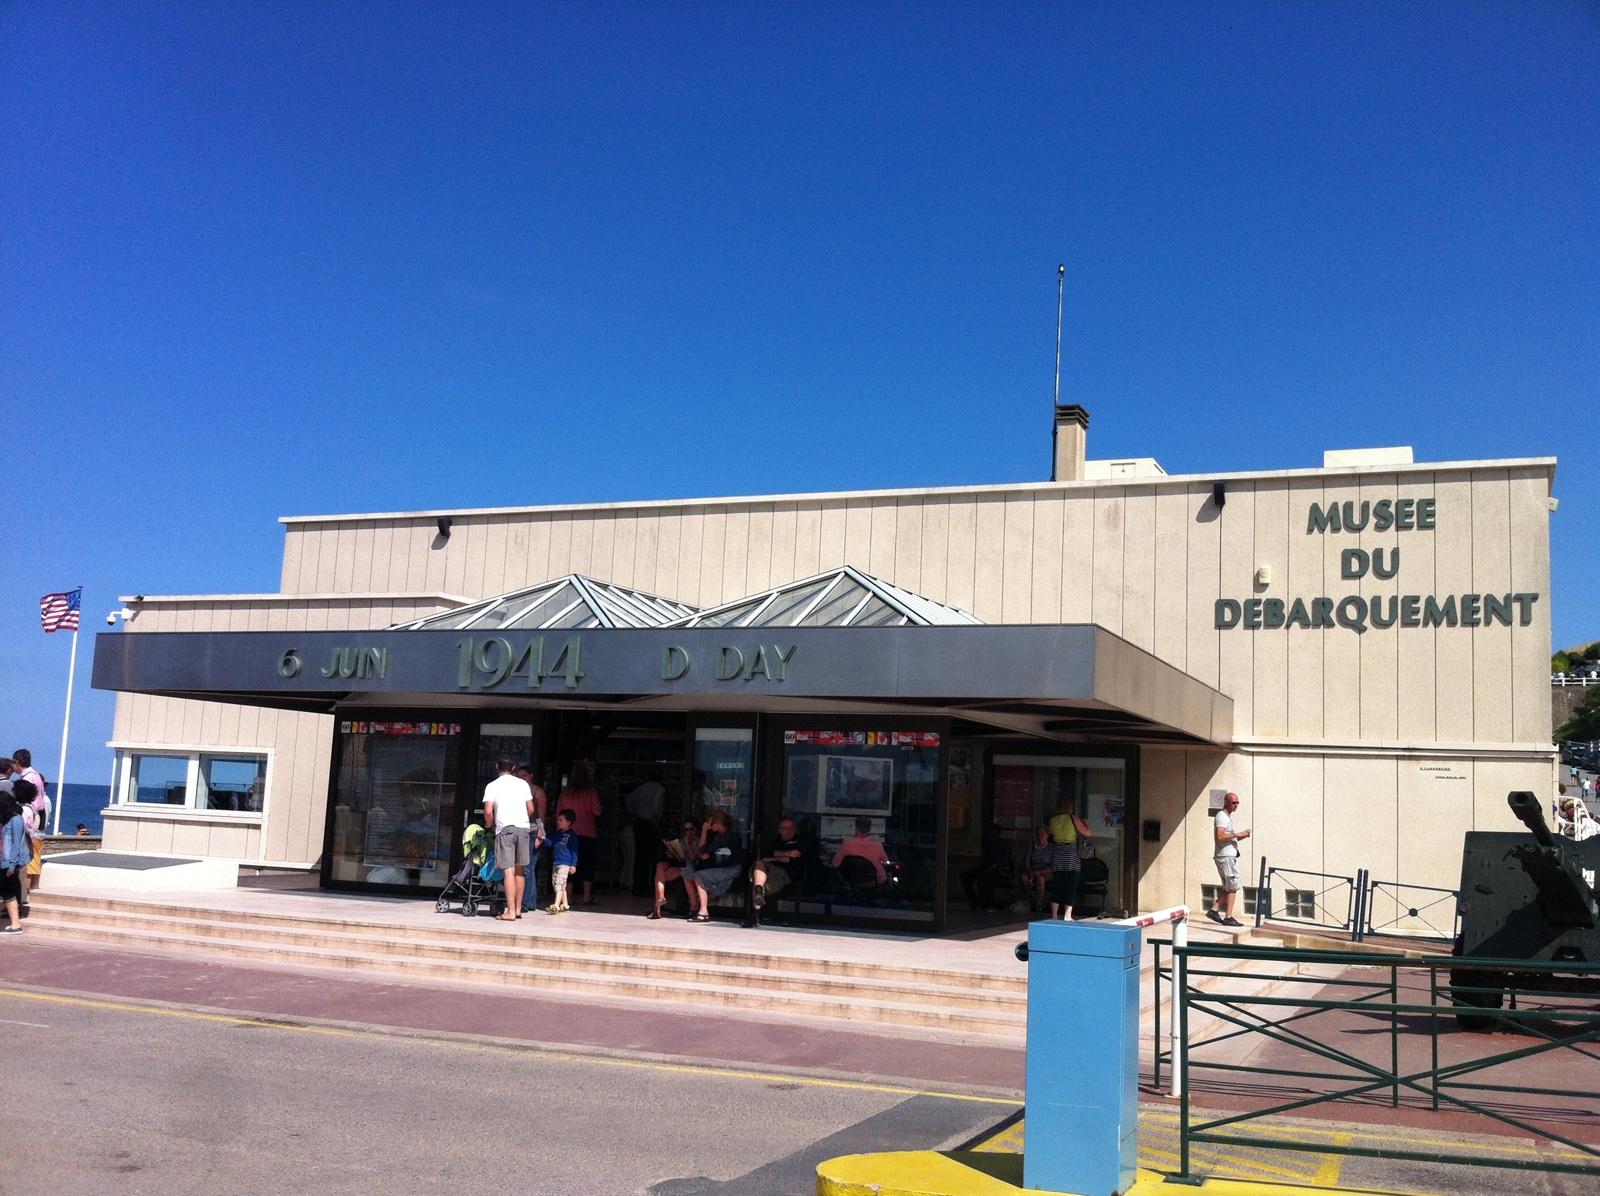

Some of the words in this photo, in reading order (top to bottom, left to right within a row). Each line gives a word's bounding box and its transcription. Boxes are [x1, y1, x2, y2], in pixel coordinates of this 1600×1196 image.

[1307, 498, 1436, 535] MUSEE
[1341, 547, 1400, 580] DU
[1215, 592, 1539, 634] DEBARQUEMENT
[278, 648, 302, 678] 6
[320, 648, 388, 679] JUIN
[457, 635, 585, 688] 1944
[661, 645, 690, 681] D
[715, 645, 798, 682] DAY
